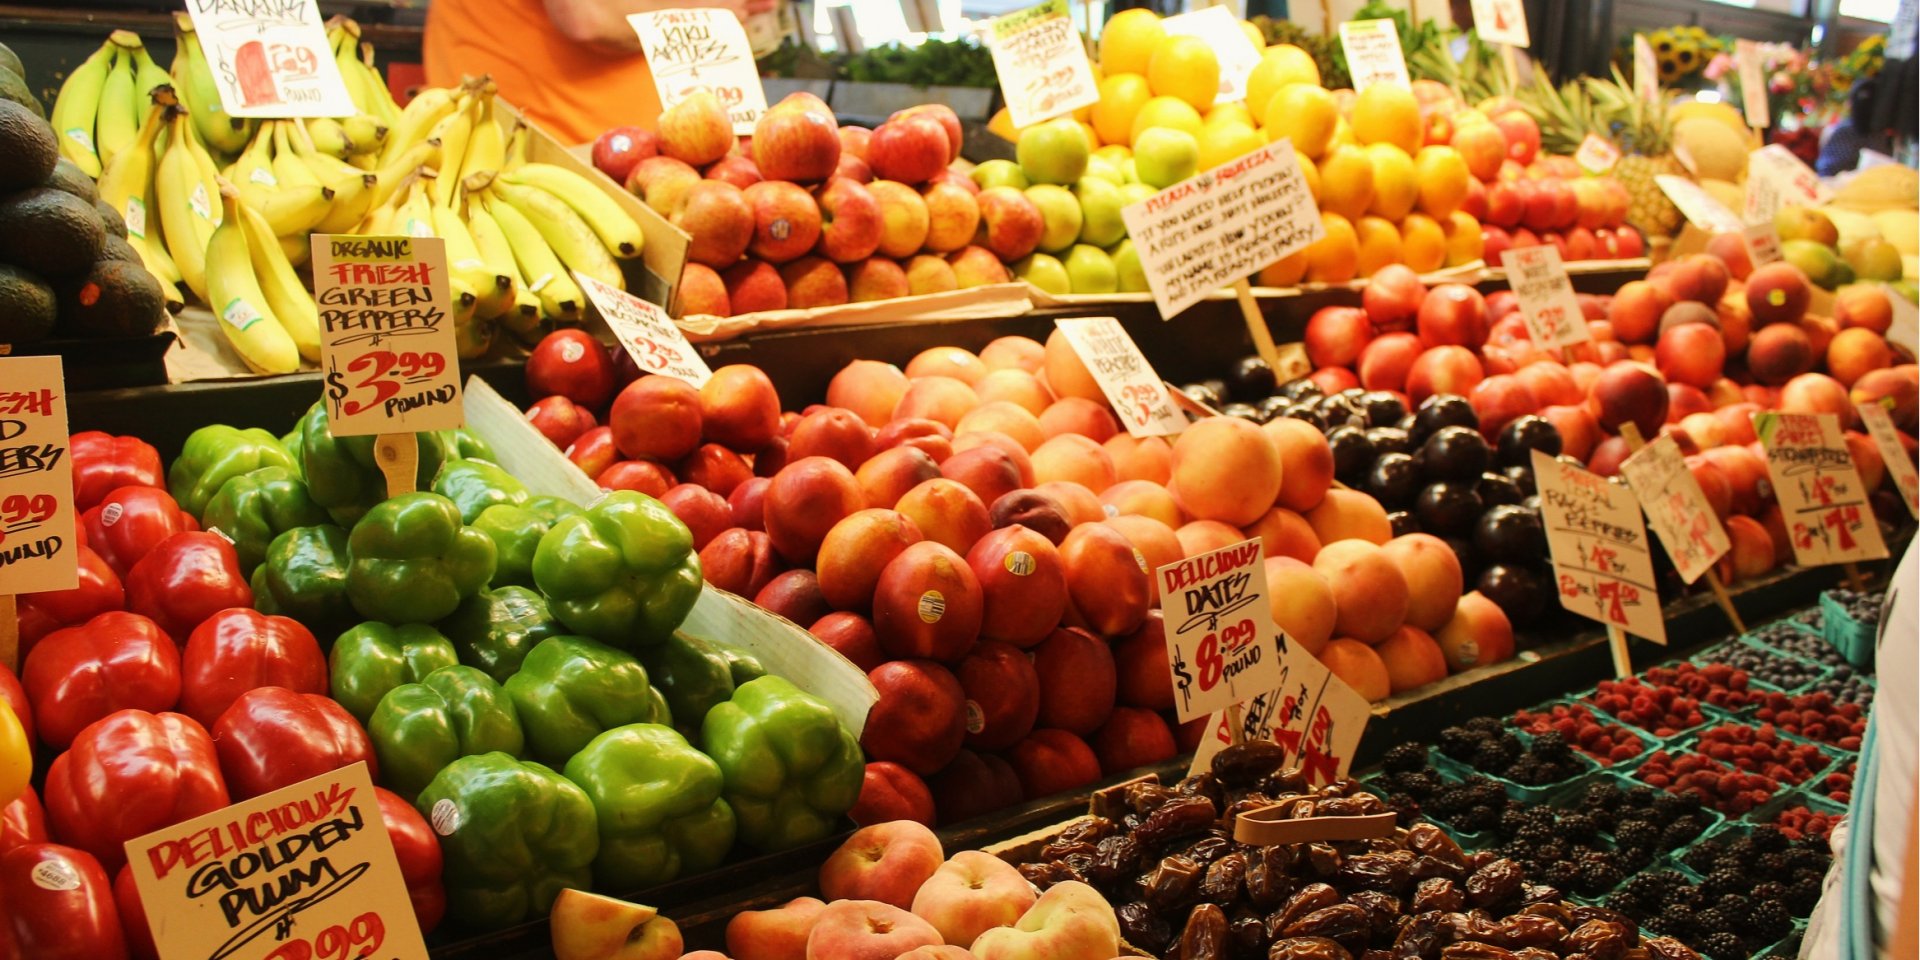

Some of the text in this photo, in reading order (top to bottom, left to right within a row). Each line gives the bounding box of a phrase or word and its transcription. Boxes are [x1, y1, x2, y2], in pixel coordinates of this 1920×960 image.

[331, 239, 411, 259] ORGANIC
[329, 262, 436, 285] FRESH
[319, 286, 433, 307] GREEN
[319, 306, 445, 332] PEPPERS
[385, 384, 456, 418] POUND
[1164, 542, 1260, 594] DELICIOUS
[1185, 571, 1251, 616] DATES
[1222, 645, 1262, 684] POUND
[147, 782, 358, 880] DELICIOUS
[186, 805, 365, 898] GOLDEN
[218, 857, 341, 929] PLUM
